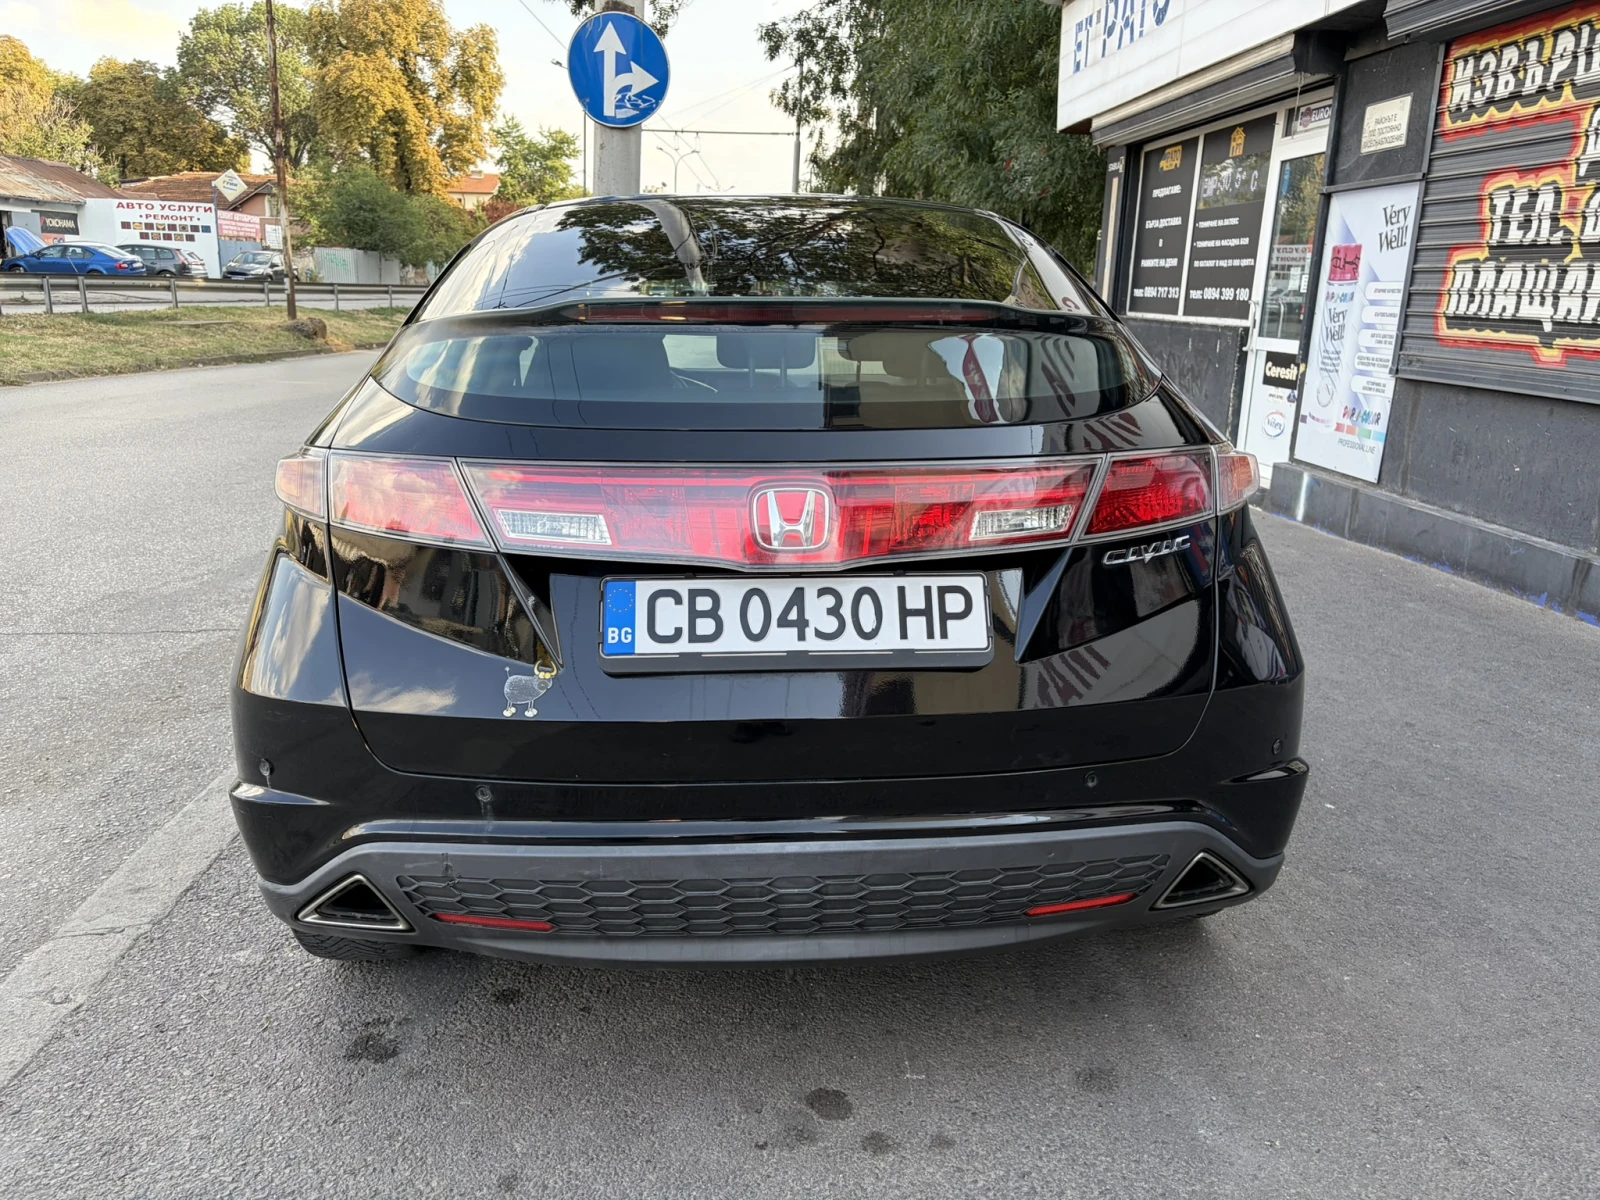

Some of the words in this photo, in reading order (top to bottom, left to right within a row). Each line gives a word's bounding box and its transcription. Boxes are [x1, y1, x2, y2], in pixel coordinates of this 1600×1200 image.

[116, 202, 155, 210] АВТО
[160, 204, 213, 213] УСЛУГИ
[1382, 204, 1411, 228] Very
[45, 217, 76, 229] YOKOHAMA
[145, 214, 194, 222] РЕМОНТ
[1378, 224, 1408, 253] Well!
[1157, 286, 1169, 298] 717
[1168, 286, 1180, 299] 313
[1203, 287, 1220, 300] 0894
[1220, 287, 1235, 301] 399
[1235, 287, 1250, 301] 180
[1328, 307, 1348, 325] Very
[1325, 324, 1346, 342] Well!
[1265, 361, 1298, 381] Ceresit
[1102, 535, 1191, 564] CIVIC
[646, 588, 724, 643] CB
[739, 586, 883, 642] 0430
[898, 585, 974, 640] HP
[607, 627, 632, 644] BG
